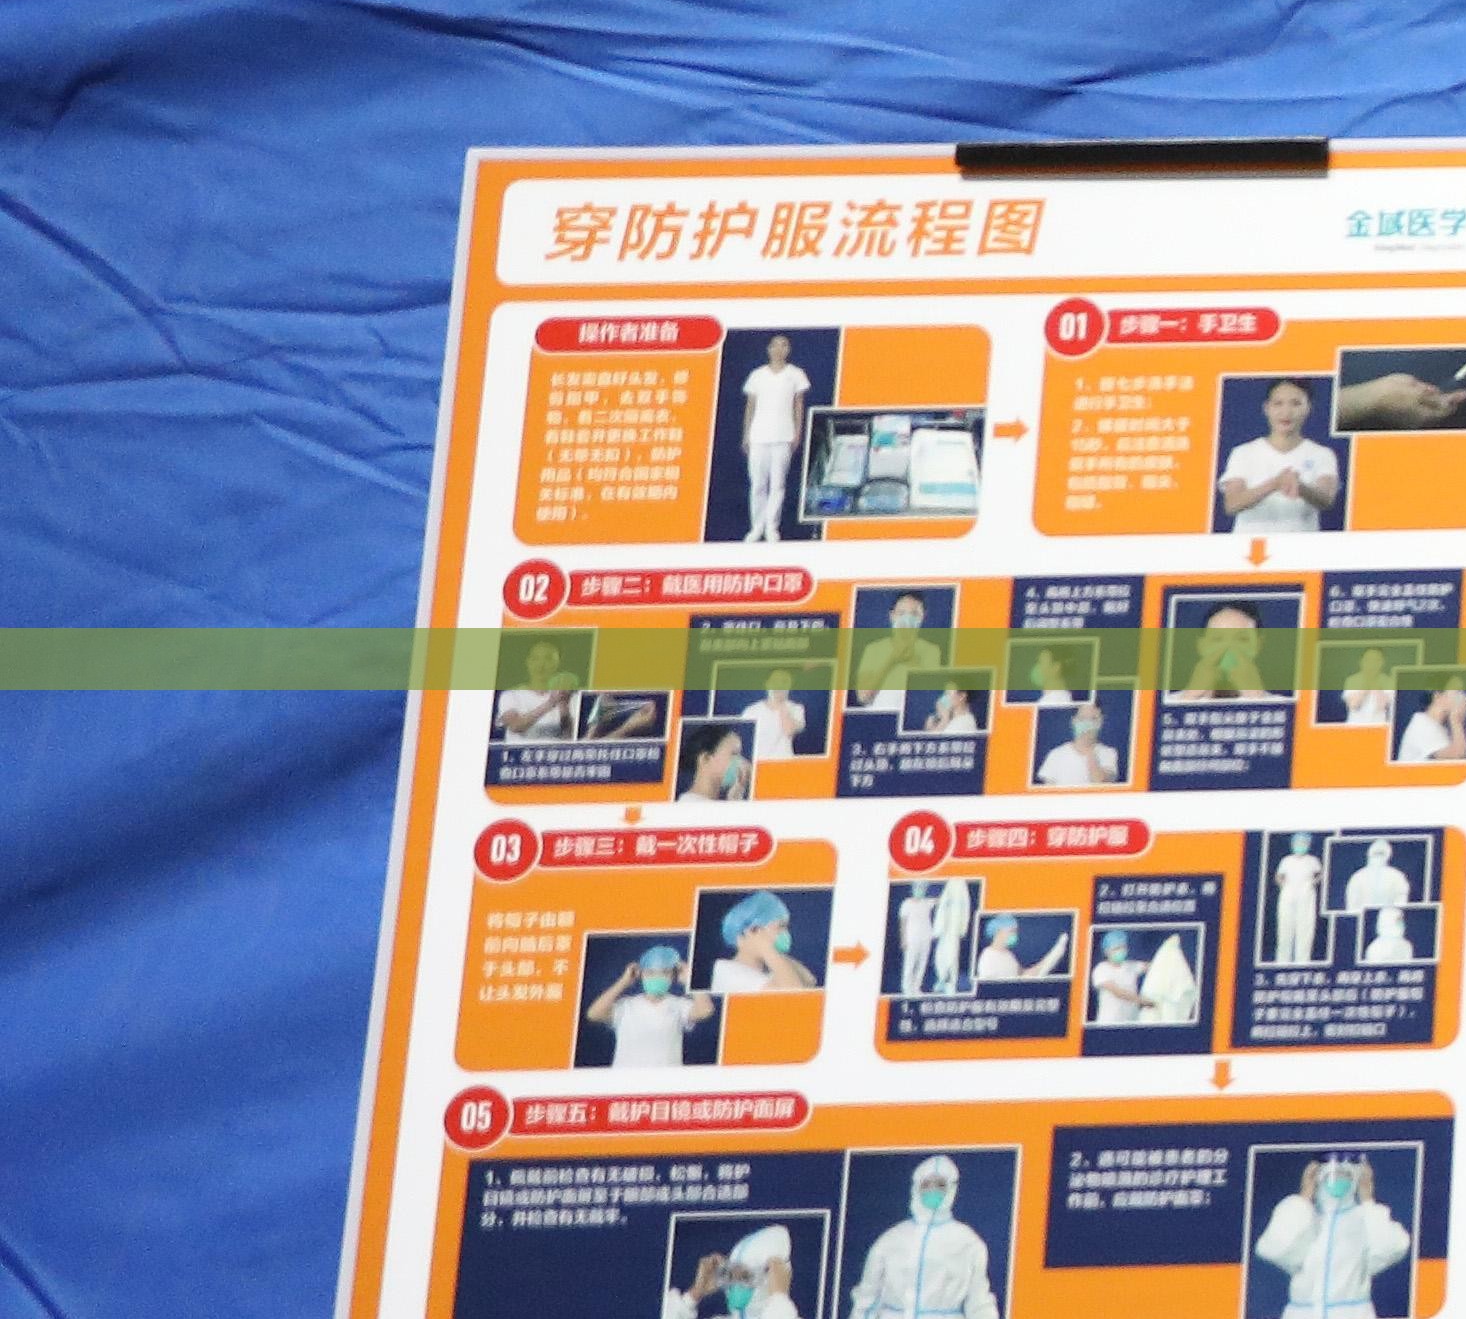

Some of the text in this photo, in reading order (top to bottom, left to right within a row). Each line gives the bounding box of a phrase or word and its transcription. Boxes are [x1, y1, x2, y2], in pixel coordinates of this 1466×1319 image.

[546, 198, 1046, 260] 穿防护服流程图
[577, 321, 679, 343] 操作者准备
[1058, 313, 1257, 341] 01 步骤一：手卫生
[518, 572, 804, 603] 02 步骤二：戴医用防护口罩
[489, 833, 759, 864] 03 步骤三：戴一次性帽子
[904, 825, 1130, 857] 04 步骤四：穿防护服
[460, 1097, 795, 1132] 05 步骤五：戴护目镜或防护面屏
